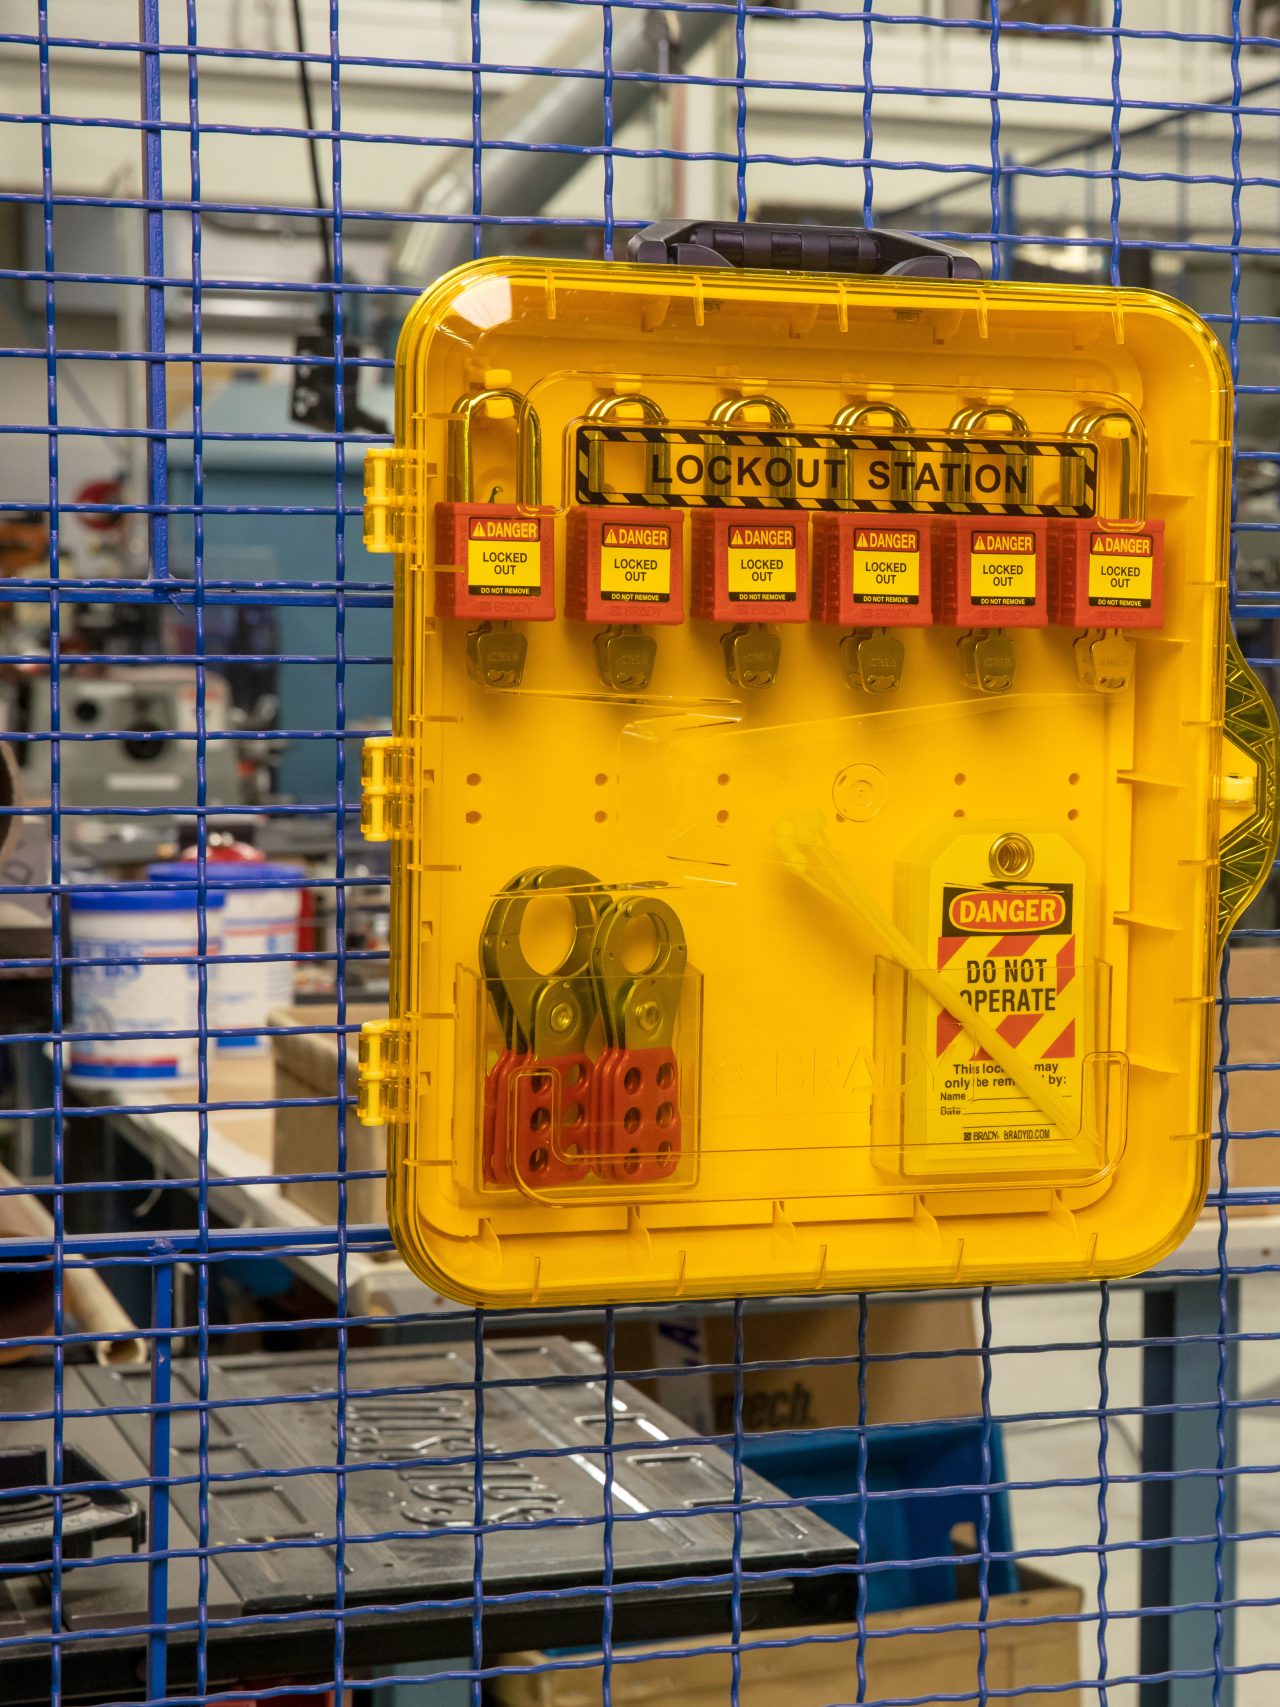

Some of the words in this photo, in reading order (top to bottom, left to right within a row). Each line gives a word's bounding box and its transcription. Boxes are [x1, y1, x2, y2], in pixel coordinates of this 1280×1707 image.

[652, 454, 846, 488] LOCKOUT
[868, 460, 1028, 494] STATION
[487, 521, 537, 538] DANGER
[619, 529, 668, 545] DANGER
[745, 530, 792, 545] DANGER
[870, 533, 916, 549] DANGER
[987, 536, 1032, 551] DANGER
[1105, 538, 1150, 554] DANGER
[482, 552, 527, 563] LOCKED
[494, 565, 516, 575] OUT
[614, 559, 657, 570] LOCKED
[741, 560, 783, 570] LOCKED
[866, 562, 907, 573] LOCKED
[983, 565, 1023, 575] LOCKED
[625, 571, 647, 582] OUT
[752, 572, 773, 581] OUT
[1101, 566, 1140, 577] LOCKED
[876, 574, 896, 584] OUT
[993, 577, 1013, 586] OUT
[1111, 578, 1130, 588] OUT
[960, 898, 1056, 923] DANGER
[967, 960, 996, 984] DO
[1005, 958, 1047, 983] NOT
[953, 1064, 979, 1074] This
[1034, 1063, 1058, 1074] may
[945, 1078, 970, 1090] only
[977, 1078, 989, 1086] be
[1048, 1074, 1066, 1086] by:
[940, 1092, 966, 1101] Name
[940, 1106, 961, 1115] Date
[1004, 1129, 1050, 1140] BRADYID.COM
